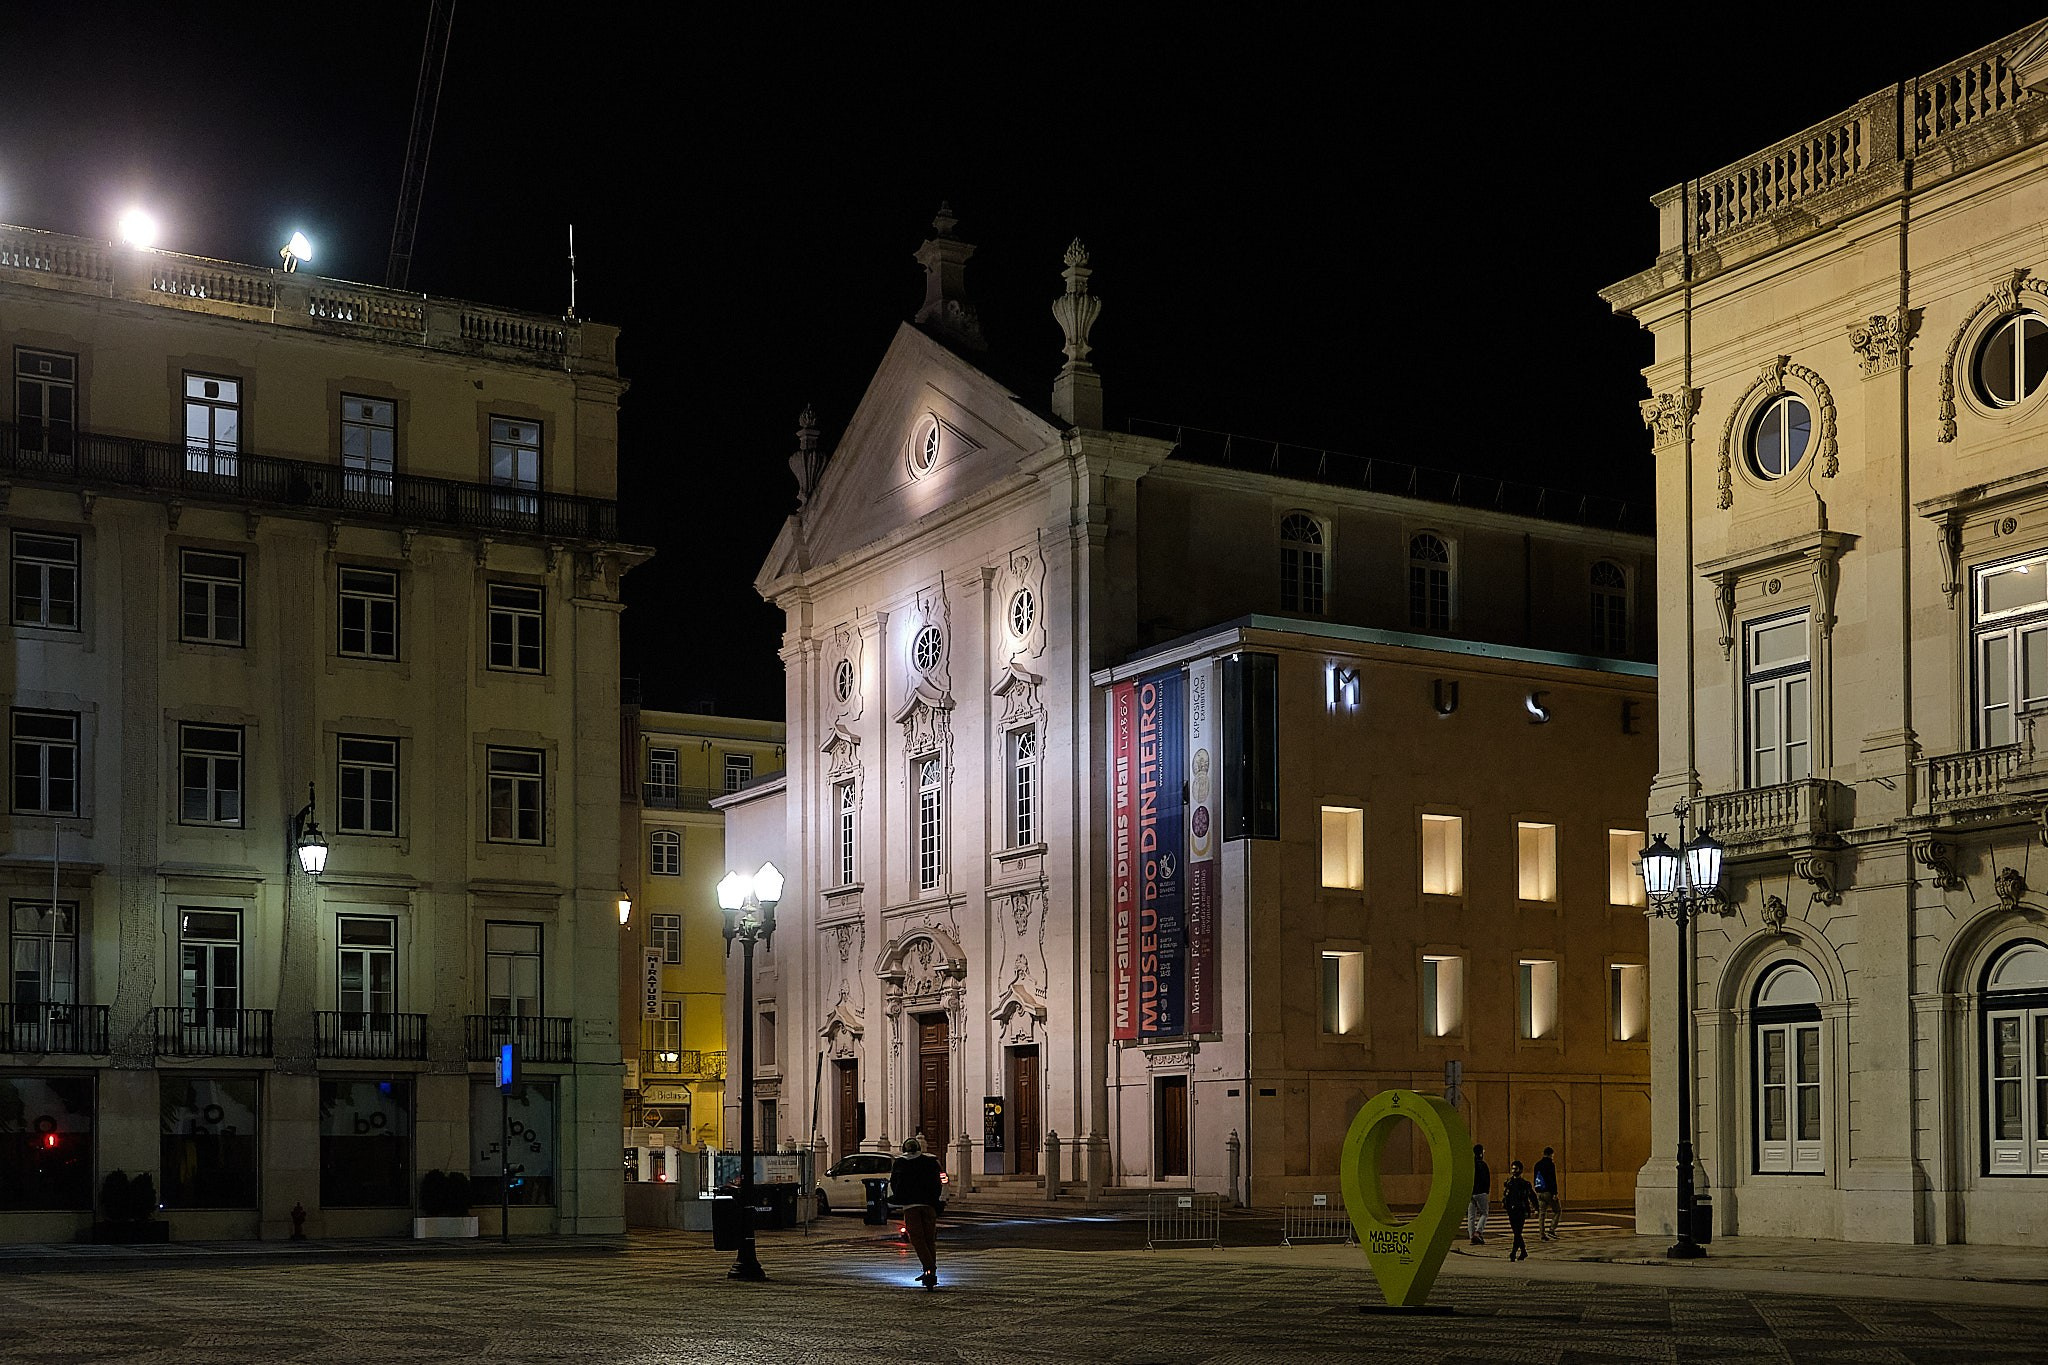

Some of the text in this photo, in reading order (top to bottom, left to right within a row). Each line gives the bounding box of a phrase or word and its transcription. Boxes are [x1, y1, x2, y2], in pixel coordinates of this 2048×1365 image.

[1192, 677, 1202, 739] EXPOSIÇÃO
[1116, 756, 1129, 809] Wall
[1139, 682, 1158, 1032] MUSEU DO DINHEIRO
[1117, 880, 1129, 903] D.
[1116, 909, 1131, 1028] Muralha
[1191, 868, 1202, 1015] Moeda, Fé e Política
[647, 956, 659, 1013] MIRATUBOS
[1370, 1231, 1414, 1243] MADE OF
[1373, 1242, 1411, 1254] LISBOA
